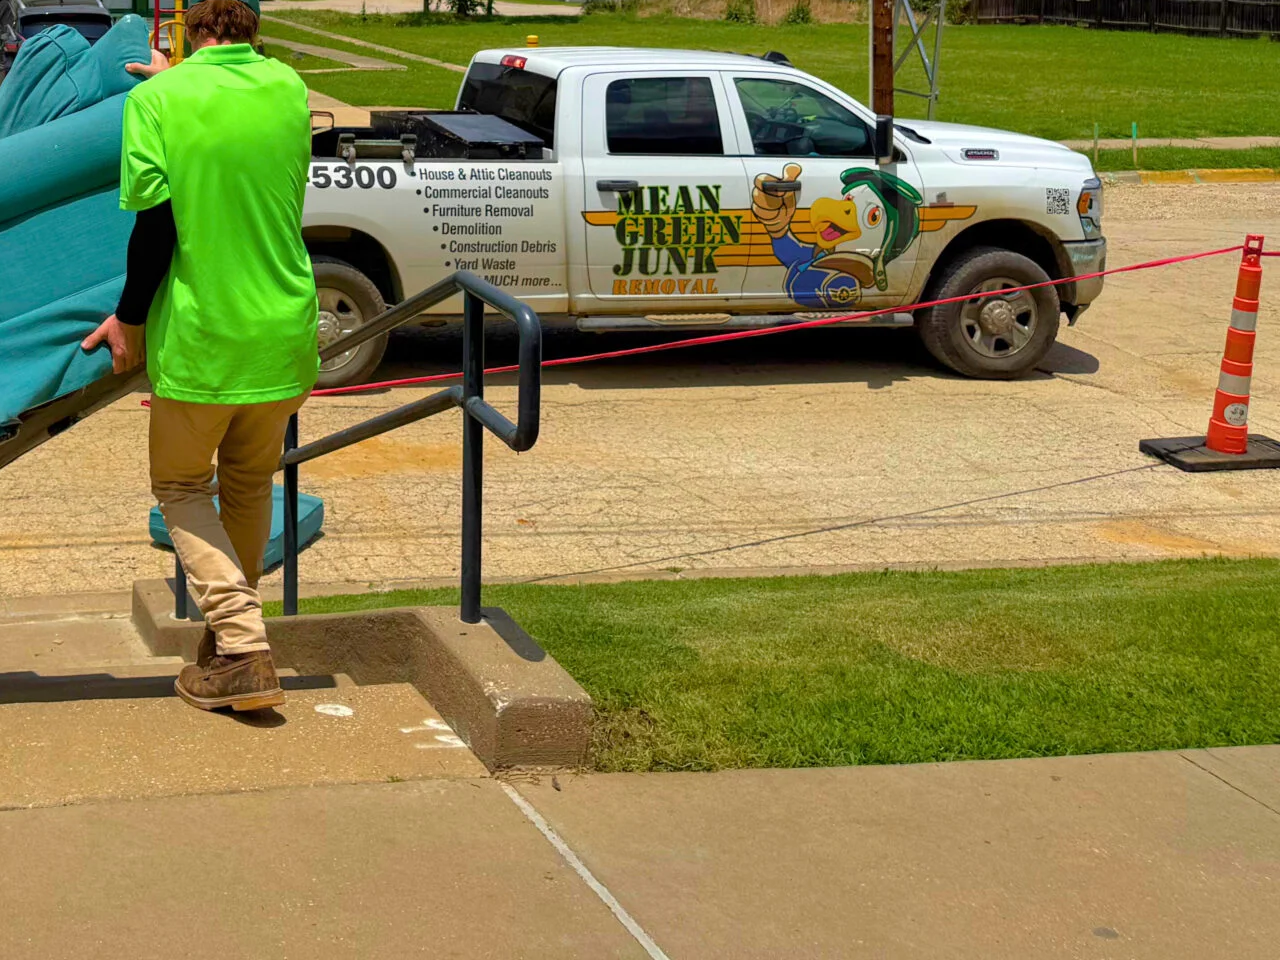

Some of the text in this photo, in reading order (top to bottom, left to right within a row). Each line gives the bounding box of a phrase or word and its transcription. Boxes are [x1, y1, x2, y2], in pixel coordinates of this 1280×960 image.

[419, 167, 552, 181] House & Attic Cleanouts
[425, 185, 549, 199] Commercial Cleanouts
[617, 185, 721, 215] MEAN
[432, 204, 534, 217] Furniture Removal
[442, 222, 502, 235] Demolition
[615, 215, 743, 246] GREEN
[449, 240, 556, 253] Construction Debris
[454, 258, 516, 270] Yard Waste
[612, 246, 719, 276] JUNK
[484, 275, 520, 287] MUCH
[612, 279, 718, 295] REMOVAL
